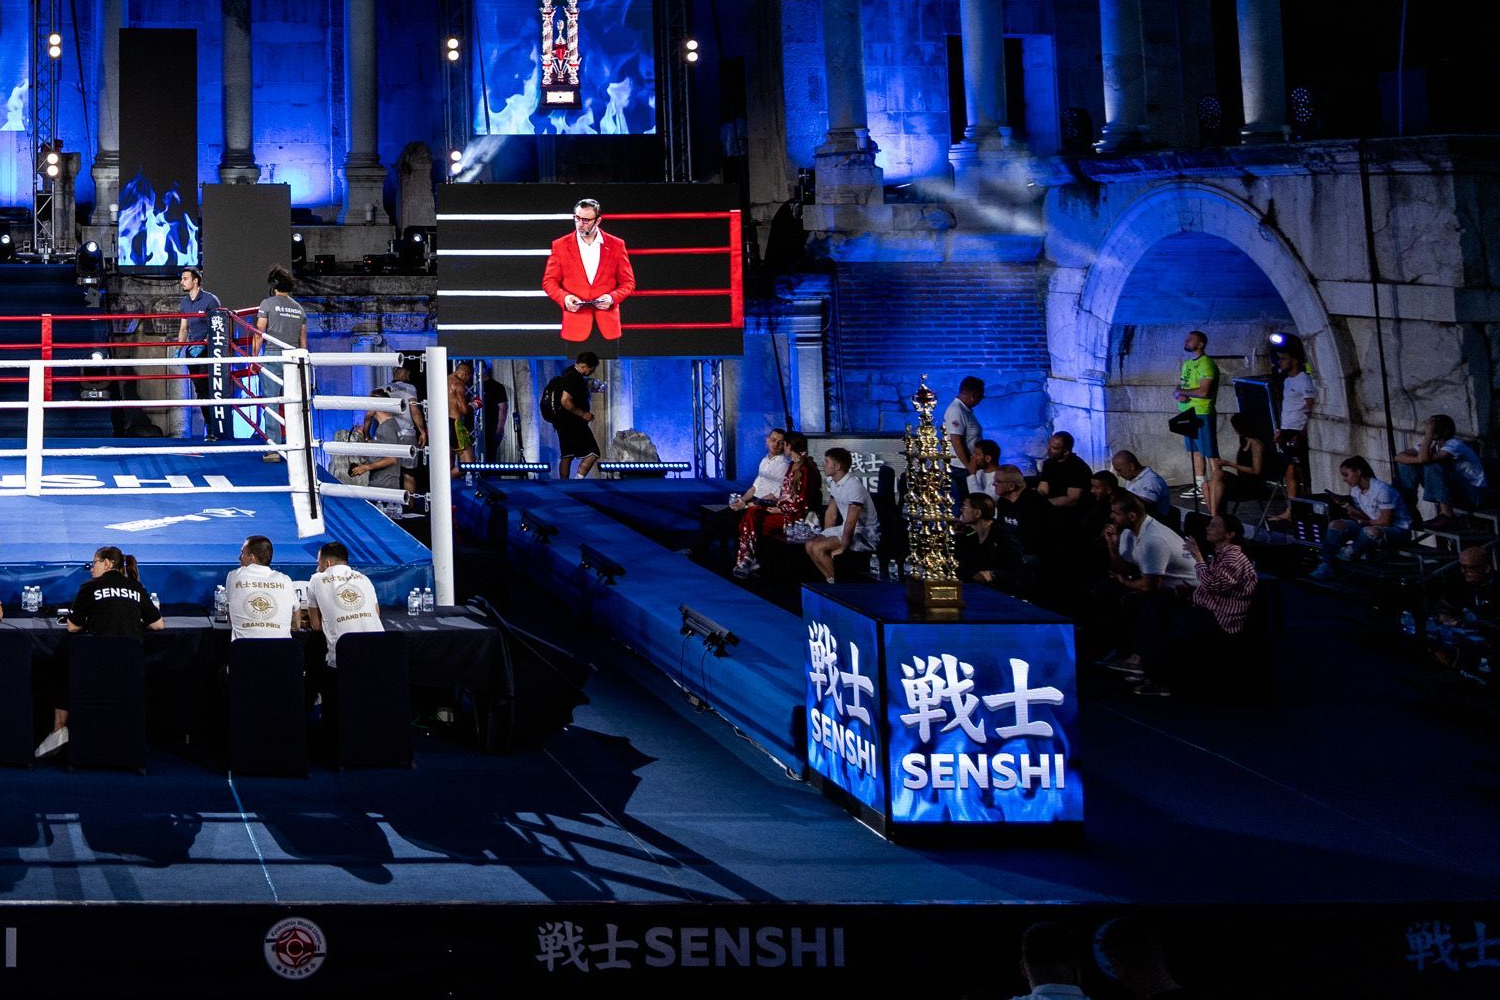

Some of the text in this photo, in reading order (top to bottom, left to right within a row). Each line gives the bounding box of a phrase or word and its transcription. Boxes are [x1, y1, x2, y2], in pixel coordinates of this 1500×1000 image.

[211, 315, 225, 347] 戦士
[94, 587, 140, 602] SENSHI
[252, 581, 285, 589] SENSHI
[336, 614, 359, 623] GRAND
[808, 620, 875, 727] 戦士
[900, 653, 1064, 744] 戦士
[811, 708, 876, 780] SENSHI
[902, 752, 1065, 790] SENSHI
[535, 920, 846, 974] 戦士 SENSHI
